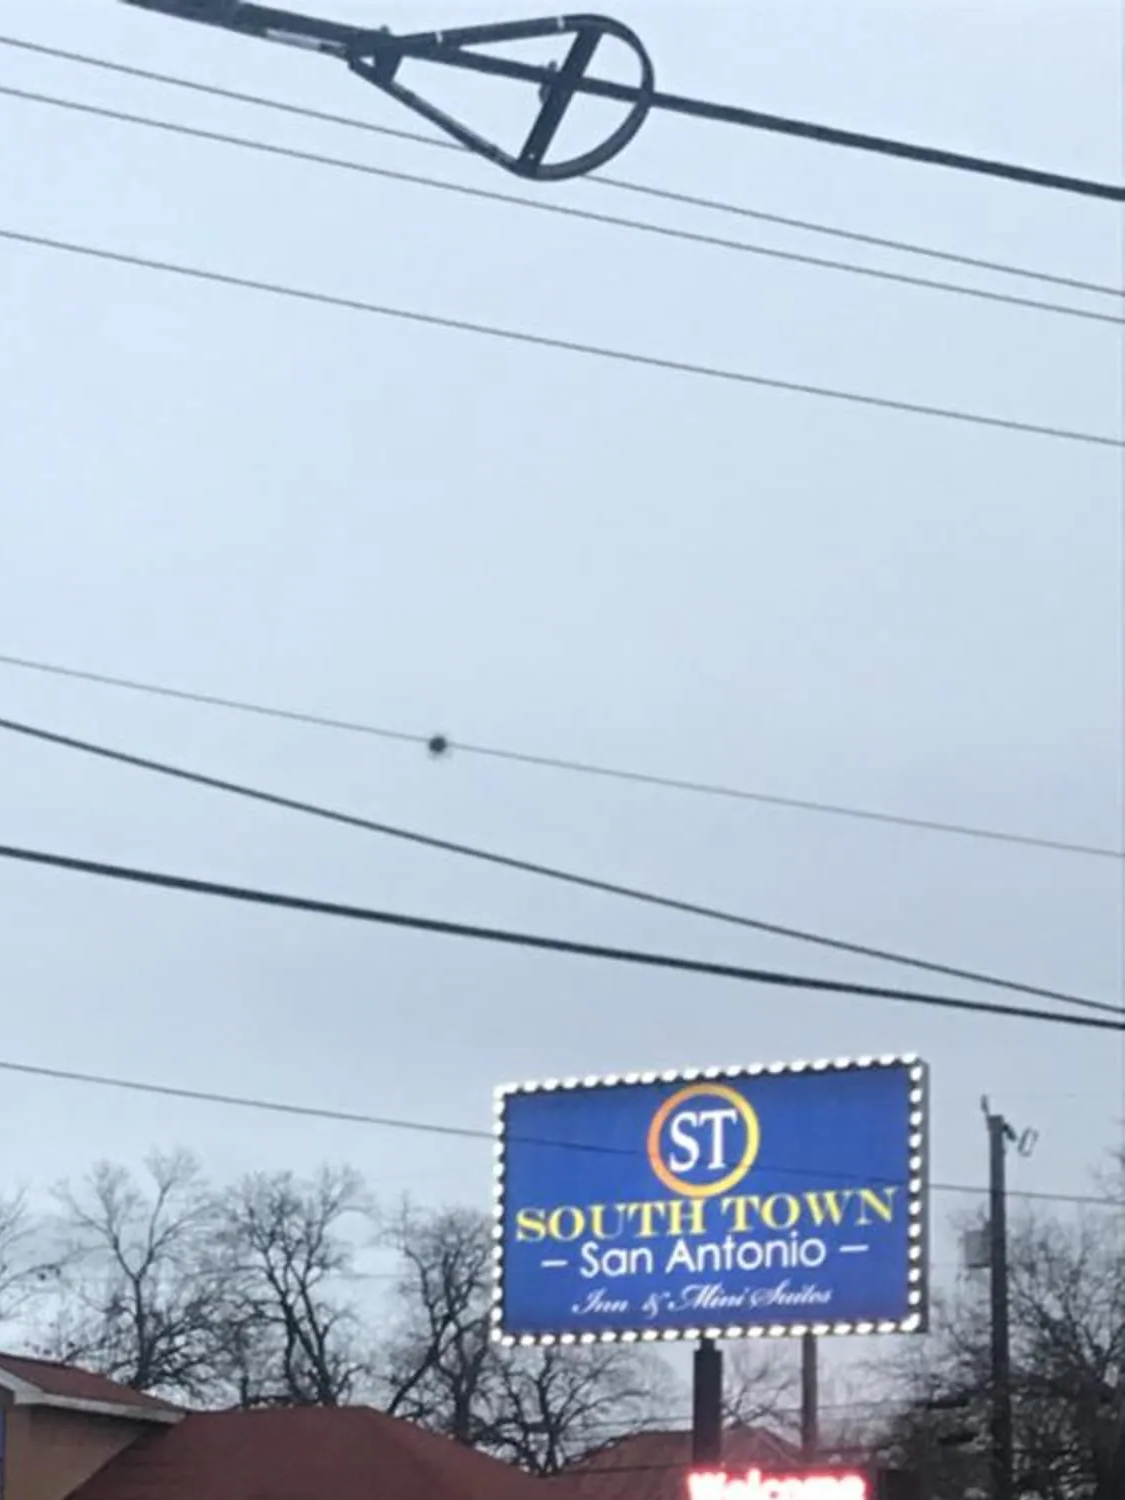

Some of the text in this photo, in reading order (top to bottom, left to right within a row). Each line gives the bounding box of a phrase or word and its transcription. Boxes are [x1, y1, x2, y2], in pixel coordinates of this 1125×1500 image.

[669, 1108, 737, 1173] ST
[515, 1187, 899, 1242] SOUTH TOWN
[580, 1230, 827, 1278] San Antonio
[572, 1278, 832, 1319] Inn & Mini Suites
